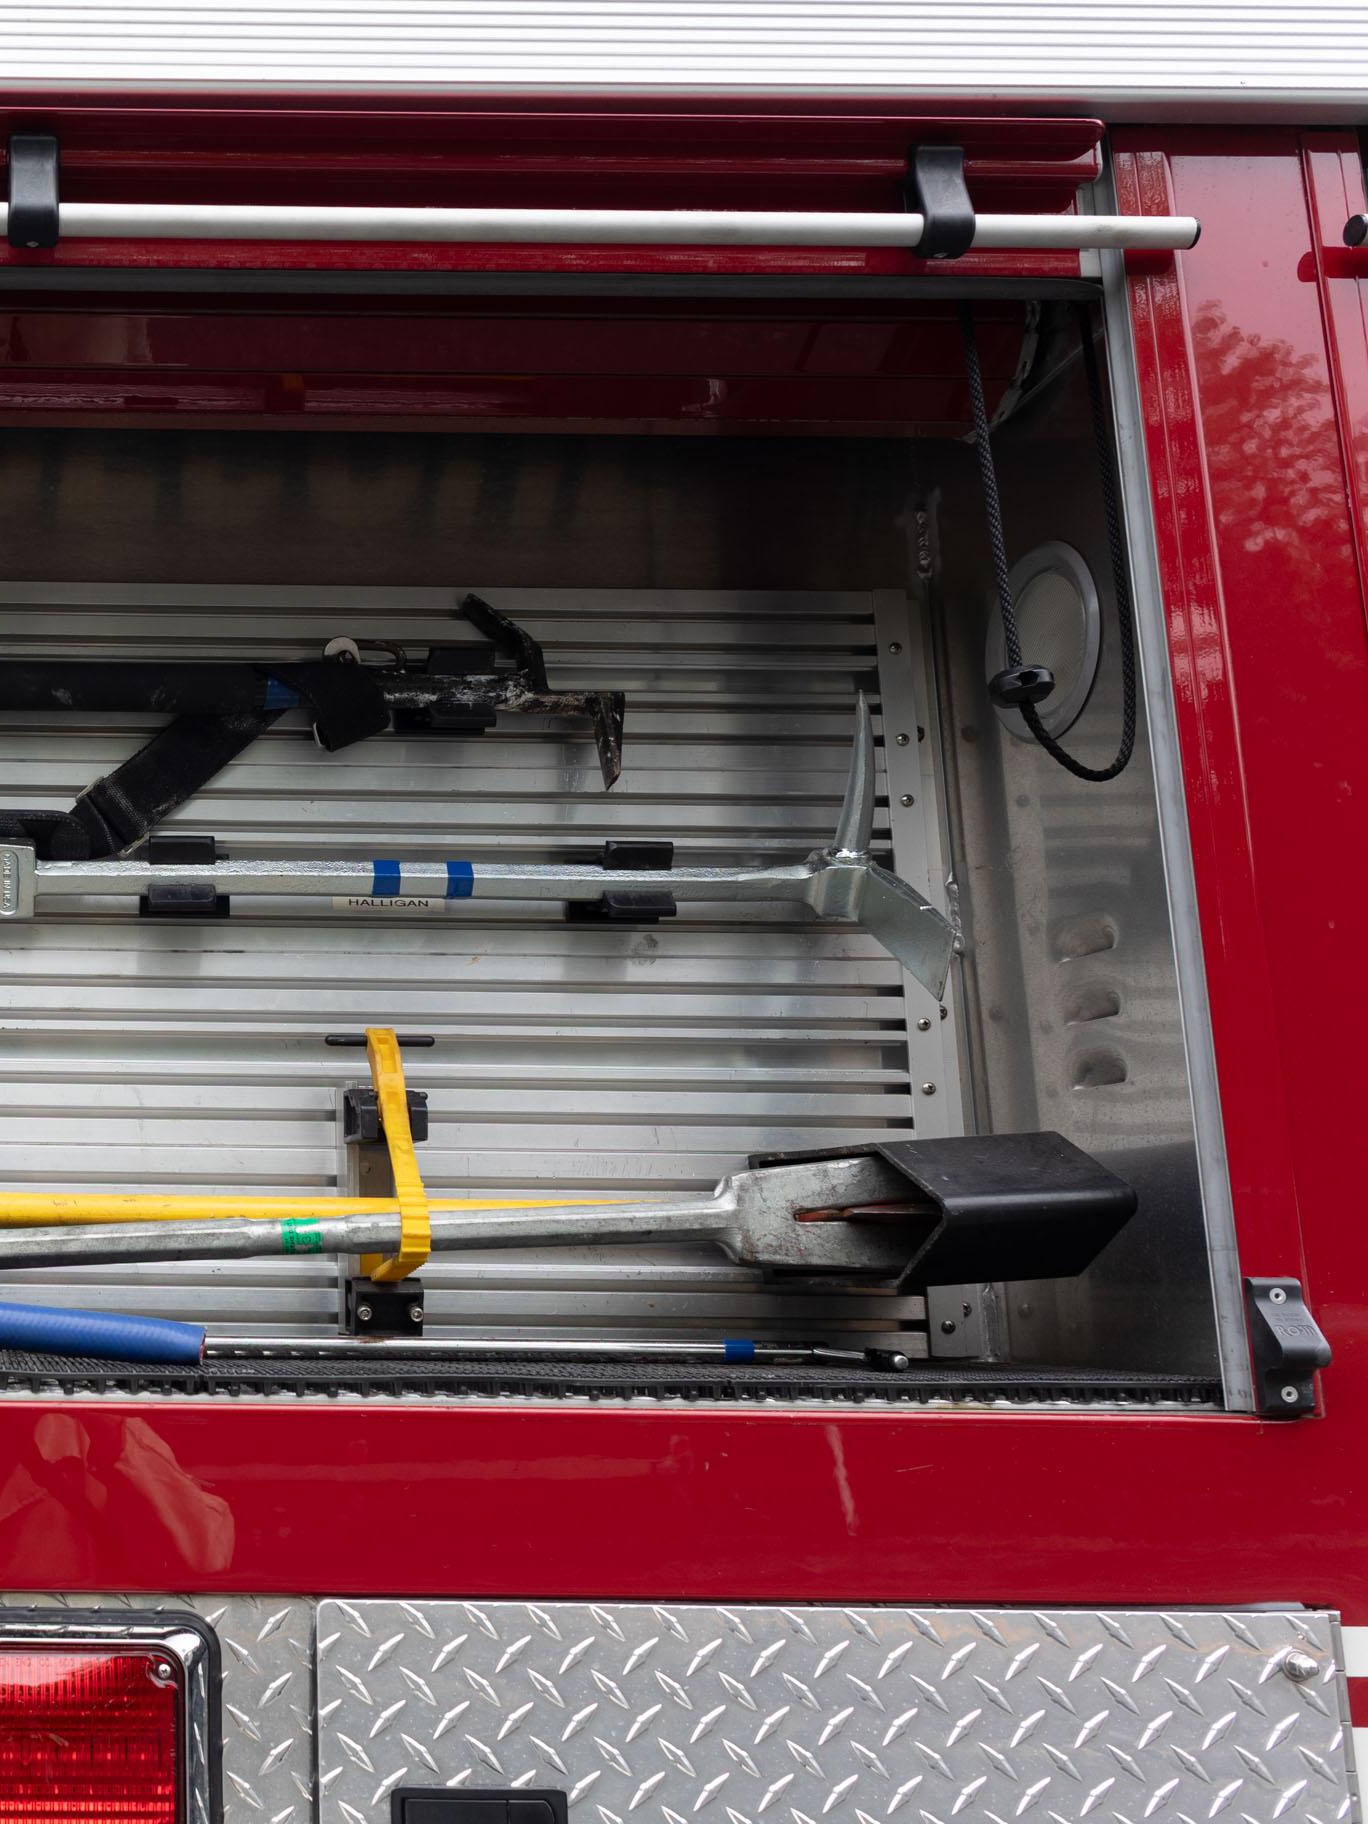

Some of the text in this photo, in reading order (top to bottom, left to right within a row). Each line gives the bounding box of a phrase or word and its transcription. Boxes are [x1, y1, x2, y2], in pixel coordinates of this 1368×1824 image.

[2, 853, 12, 878] MADE
[2, 880, 12, 889] IN
[348, 898, 429, 908] HALLIGAN
